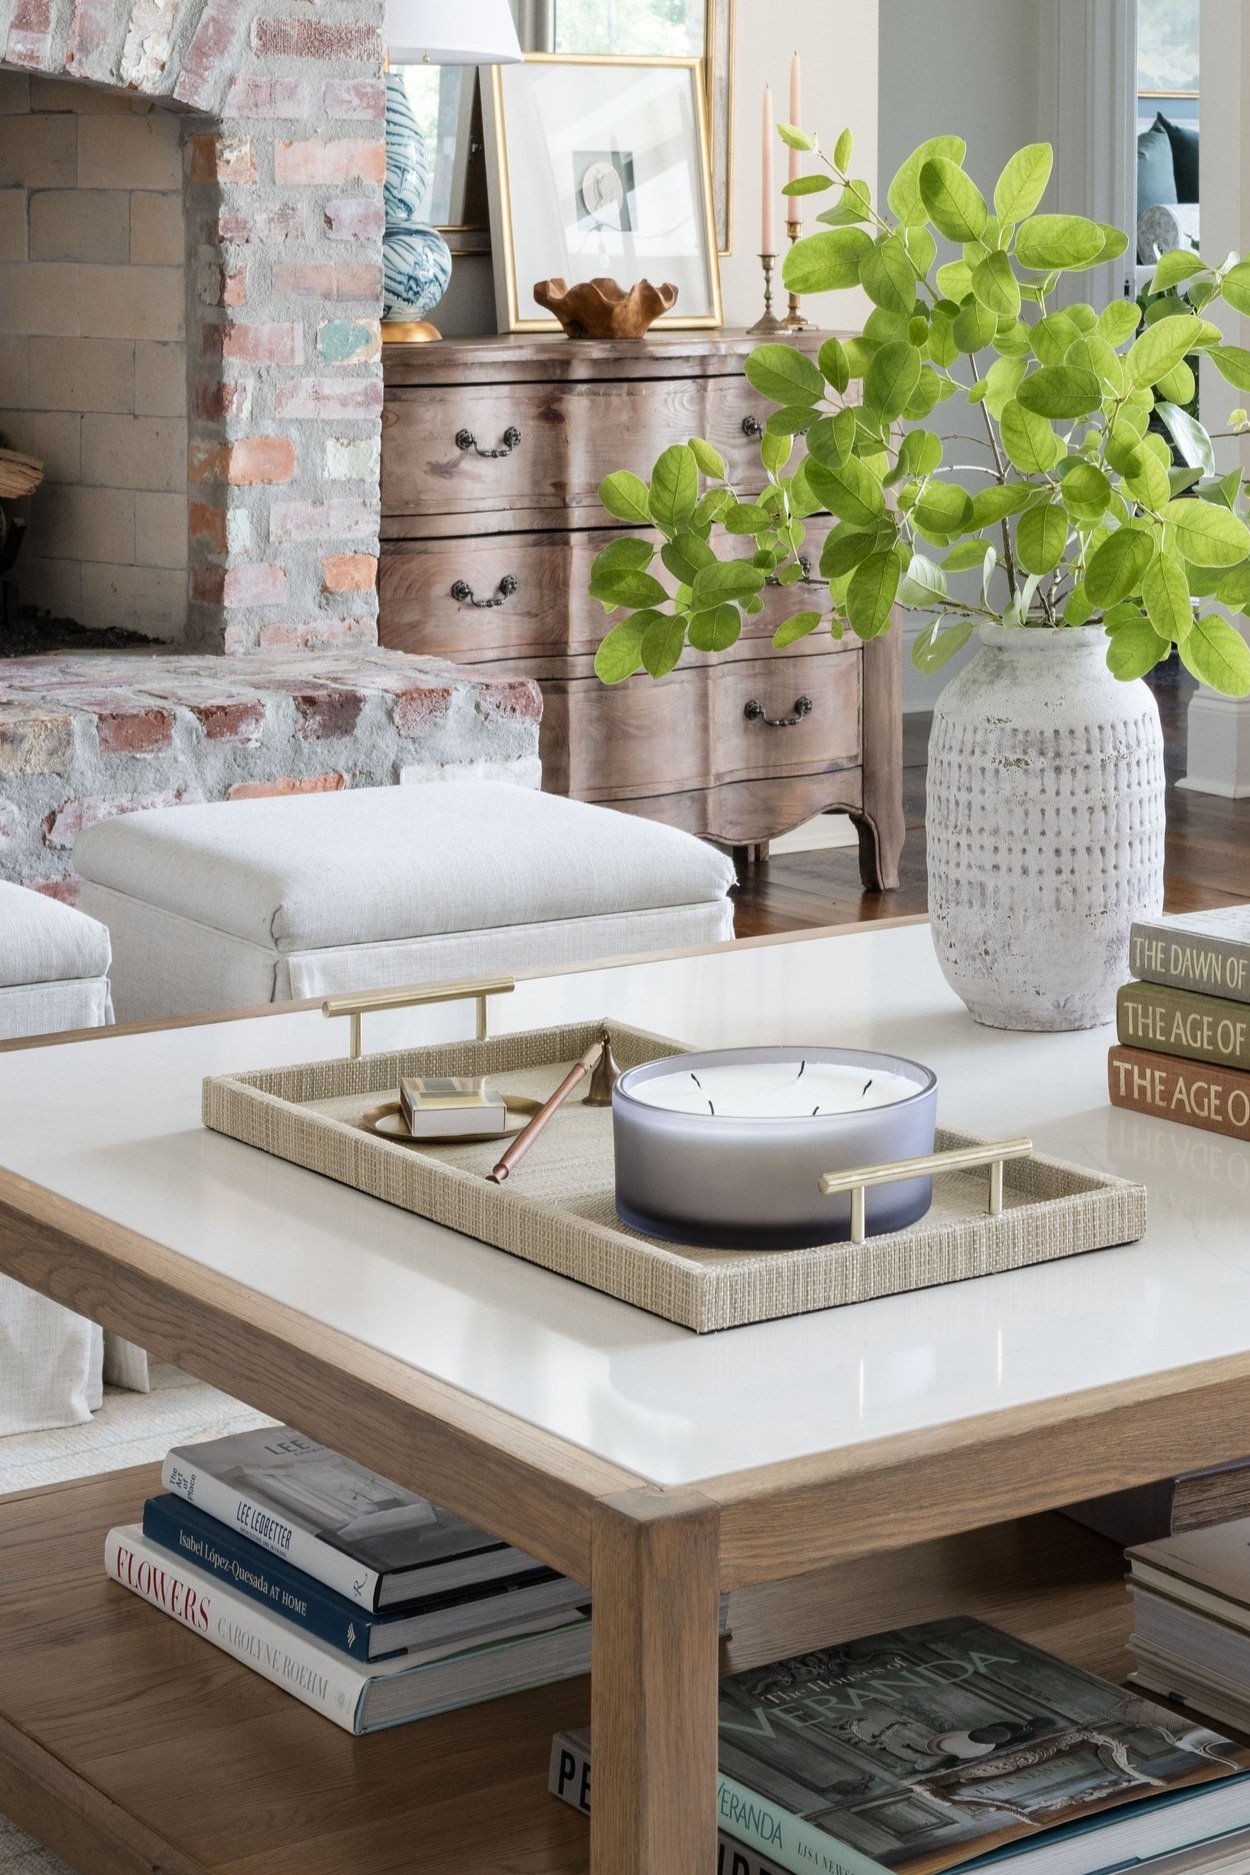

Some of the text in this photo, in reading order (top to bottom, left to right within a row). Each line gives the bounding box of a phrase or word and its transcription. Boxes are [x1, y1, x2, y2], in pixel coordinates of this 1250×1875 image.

[1133, 937, 1166, 973] THE
[1170, 944, 1222, 984] DAWN
[1226, 956, 1247, 989] OF
[1123, 1002, 1166, 1041] THE
[1170, 1011, 1214, 1050] AGE
[1217, 1019, 1247, 1056] OF
[1112, 1060, 1167, 1107] THE
[1170, 1076, 1223, 1122] AGE
[263, 1439, 311, 1455] LEE
[169, 1467, 178, 1486] The
[175, 1472, 184, 1489] Art
[183, 1477, 189, 1490] of
[187, 1474, 197, 1502] Place
[236, 1501, 293, 1551] LEE LEDBETTER
[179, 1529, 308, 1617] Isabel López-Quesada AT HOME
[116, 1545, 330, 1701] FLOWERS CAROLYNE ROEHM
[718, 1650, 1021, 1739] VERANDA
[760, 1657, 908, 1704] The Houses of
[797, 1841, 819, 1865] LISA
[822, 1855, 856, 1875] NEWS
